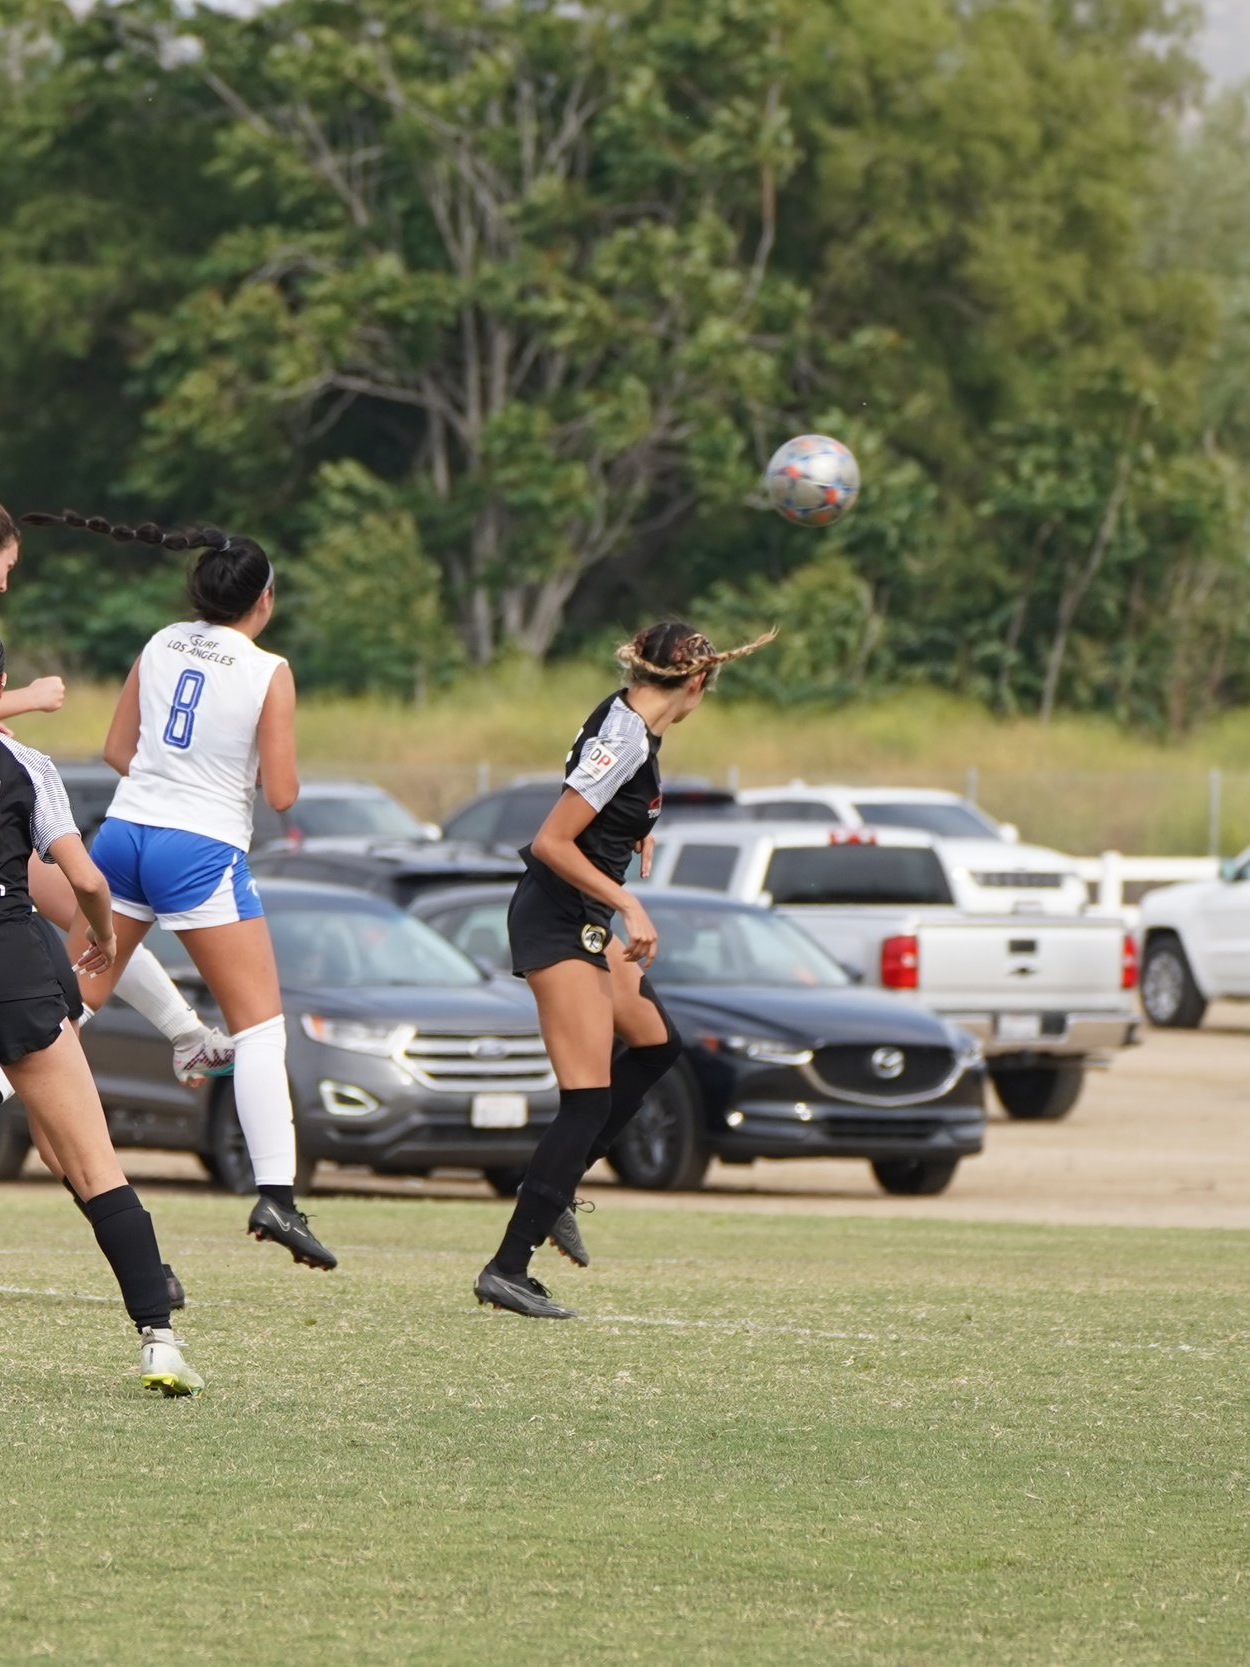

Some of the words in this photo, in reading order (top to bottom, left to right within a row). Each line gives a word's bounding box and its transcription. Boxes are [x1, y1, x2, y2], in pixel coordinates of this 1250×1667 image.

[167, 640, 188, 653] LOS
[186, 648, 236, 666] ANGELES
[190, 636, 220, 649] SURF
[163, 669, 205, 750] 8
